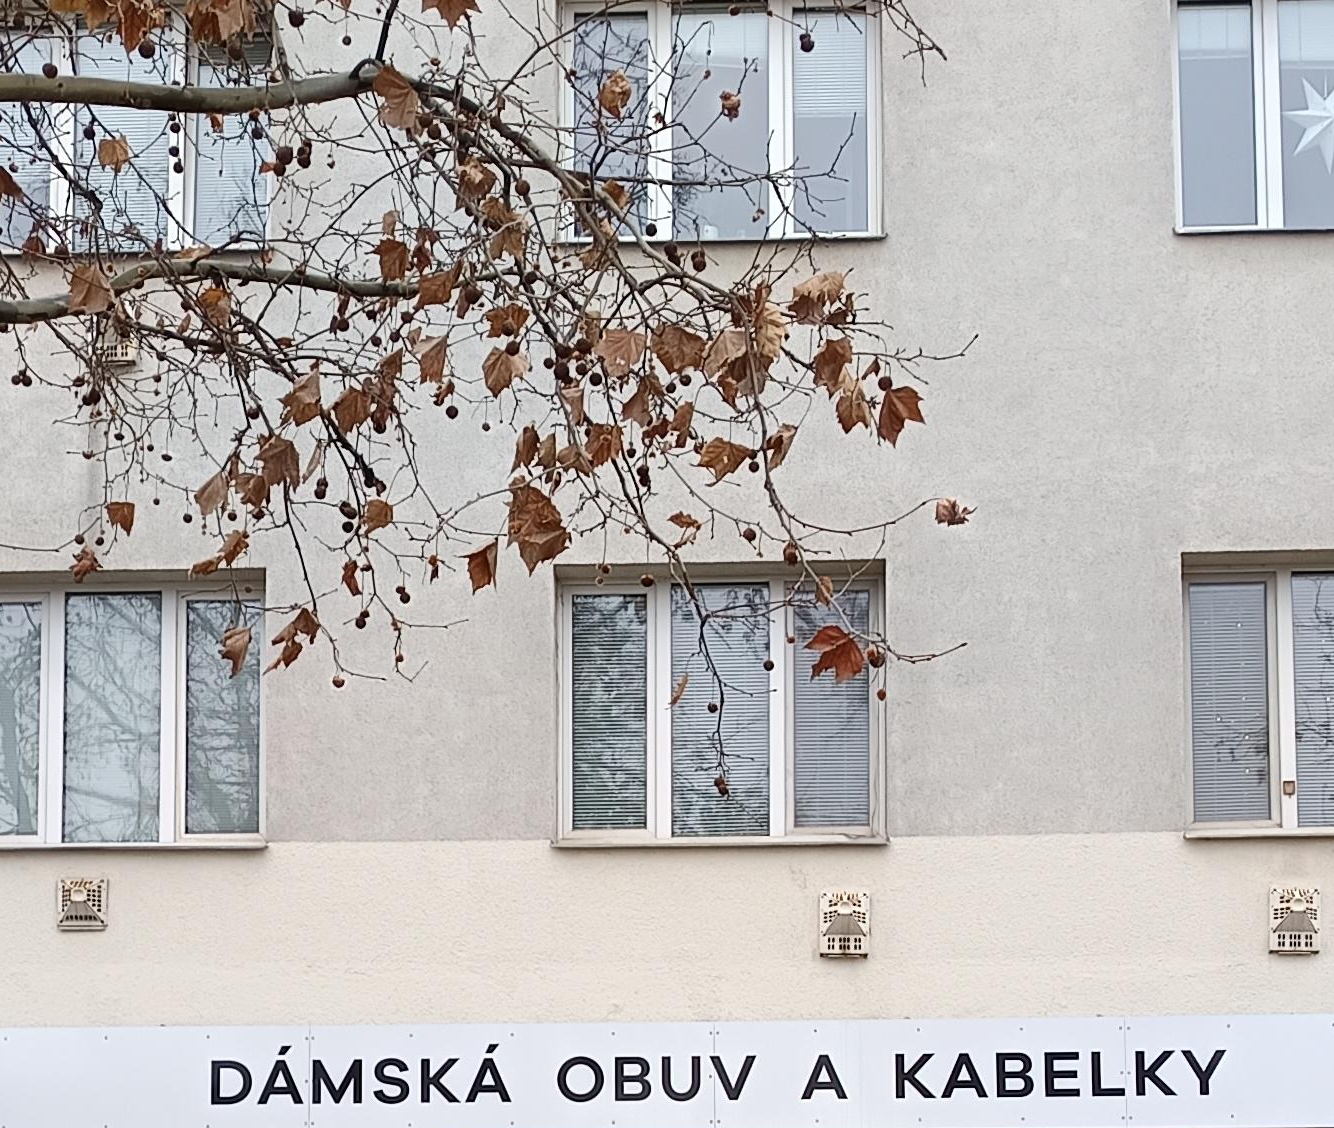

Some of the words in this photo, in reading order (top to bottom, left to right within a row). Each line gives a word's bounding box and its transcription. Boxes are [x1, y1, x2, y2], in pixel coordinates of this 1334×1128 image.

[210, 1043, 512, 1105] DÁMSKÁ
[556, 1055, 756, 1102] OBUV
[800, 1054, 848, 1100] A
[895, 1049, 1227, 1099] KABELKY
